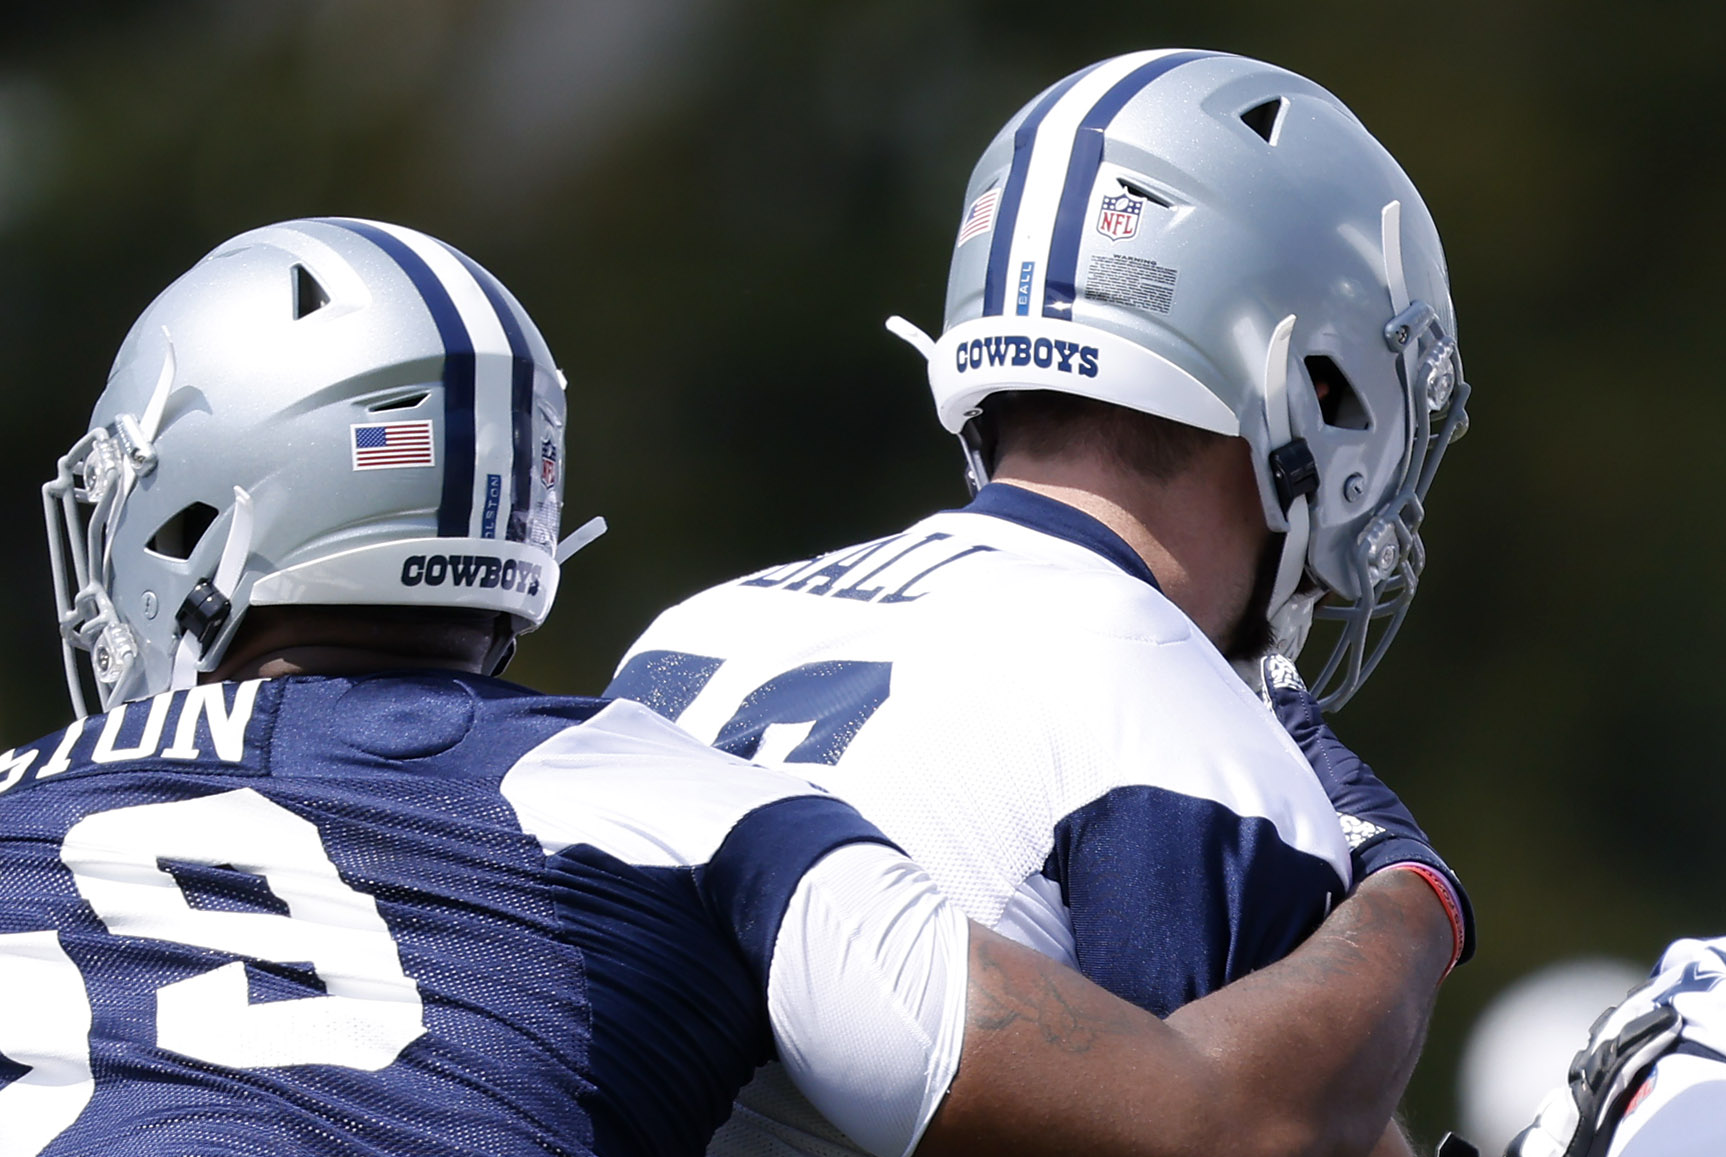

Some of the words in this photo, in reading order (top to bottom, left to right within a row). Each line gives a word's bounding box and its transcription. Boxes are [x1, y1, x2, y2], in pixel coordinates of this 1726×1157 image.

[1099, 211, 1134, 235] NFL
[1113, 254, 1157, 266] WARNING
[1018, 264, 1033, 305] BALL
[956, 335, 1099, 378] COWBOYS
[401, 554, 543, 596] COWBOYS
